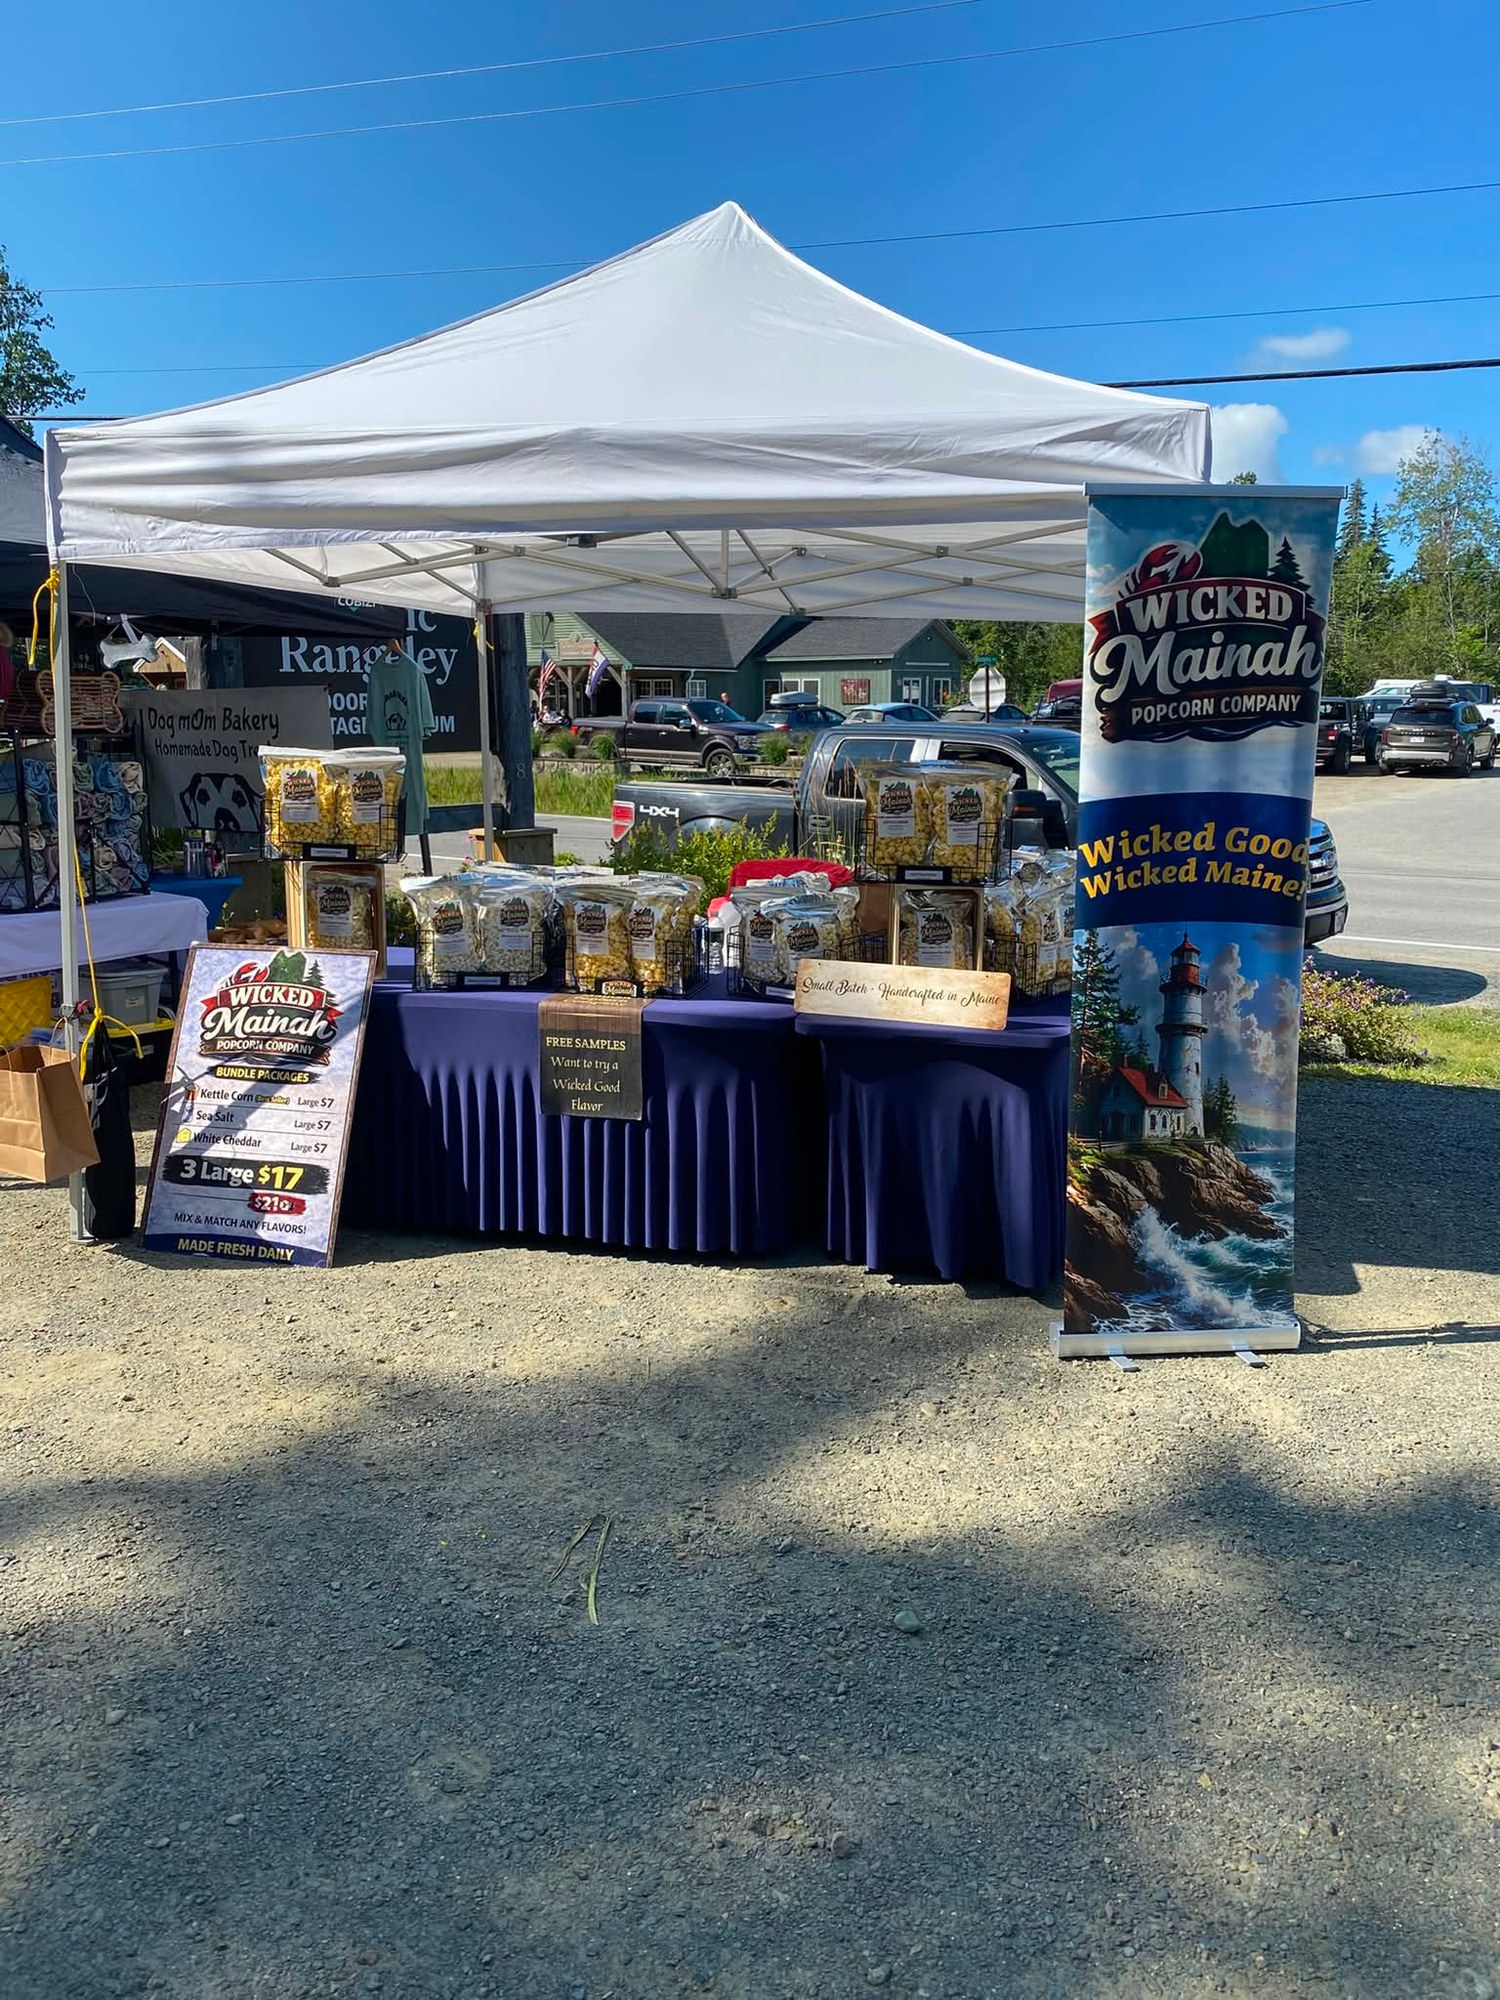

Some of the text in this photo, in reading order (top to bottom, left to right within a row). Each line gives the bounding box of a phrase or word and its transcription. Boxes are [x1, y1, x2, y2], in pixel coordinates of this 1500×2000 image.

[1126, 585, 1293, 633] WICKED
[1094, 625, 1321, 703] Mainah
[1131, 694, 1302, 726] POPCORN COMPANY
[148, 707, 175, 738] Dog
[222, 706, 280, 740] Bakery
[155, 738, 212, 757] Homemade
[212, 740, 239, 764] Dog
[1078, 821, 1310, 868] Wicked Good
[1080, 857, 1306, 901] Wicked Maine!
[228, 985, 315, 1008] WICKED
[801, 976, 834, 994] Small
[834, 978, 868, 996] Batch
[877, 983, 945, 1007] Handcrafted
[947, 991, 958, 1001] in
[960, 990, 1001, 1008] Maine
[203, 1006, 334, 1041] Mainah
[216, 1039, 315, 1055] POPCORN COMPANY
[546, 1036, 627, 1051] FREE SAMPLES
[216, 1066, 310, 1083] BUNDLE PACKAGES
[551, 1056, 619, 1074] Want to try a
[553, 1077, 621, 1093] Wicked Good
[200, 1088, 230, 1101] Kettle
[231, 1090, 254, 1102] Corn
[297, 1097, 319, 1108] Large
[320, 1097, 335, 1108] $7
[571, 1097, 604, 1112] Flavor
[196, 1110, 332, 1131] Sea Salt Large $7
[193, 1132, 328, 1154] White Cheddar Large $7
[180, 1158, 304, 1191] 3 Large $17
[174, 1212, 307, 1235] MIX & MATCH ANY FLAVORS!
[177, 1237, 295, 1262] MADE FRESH DAILY
